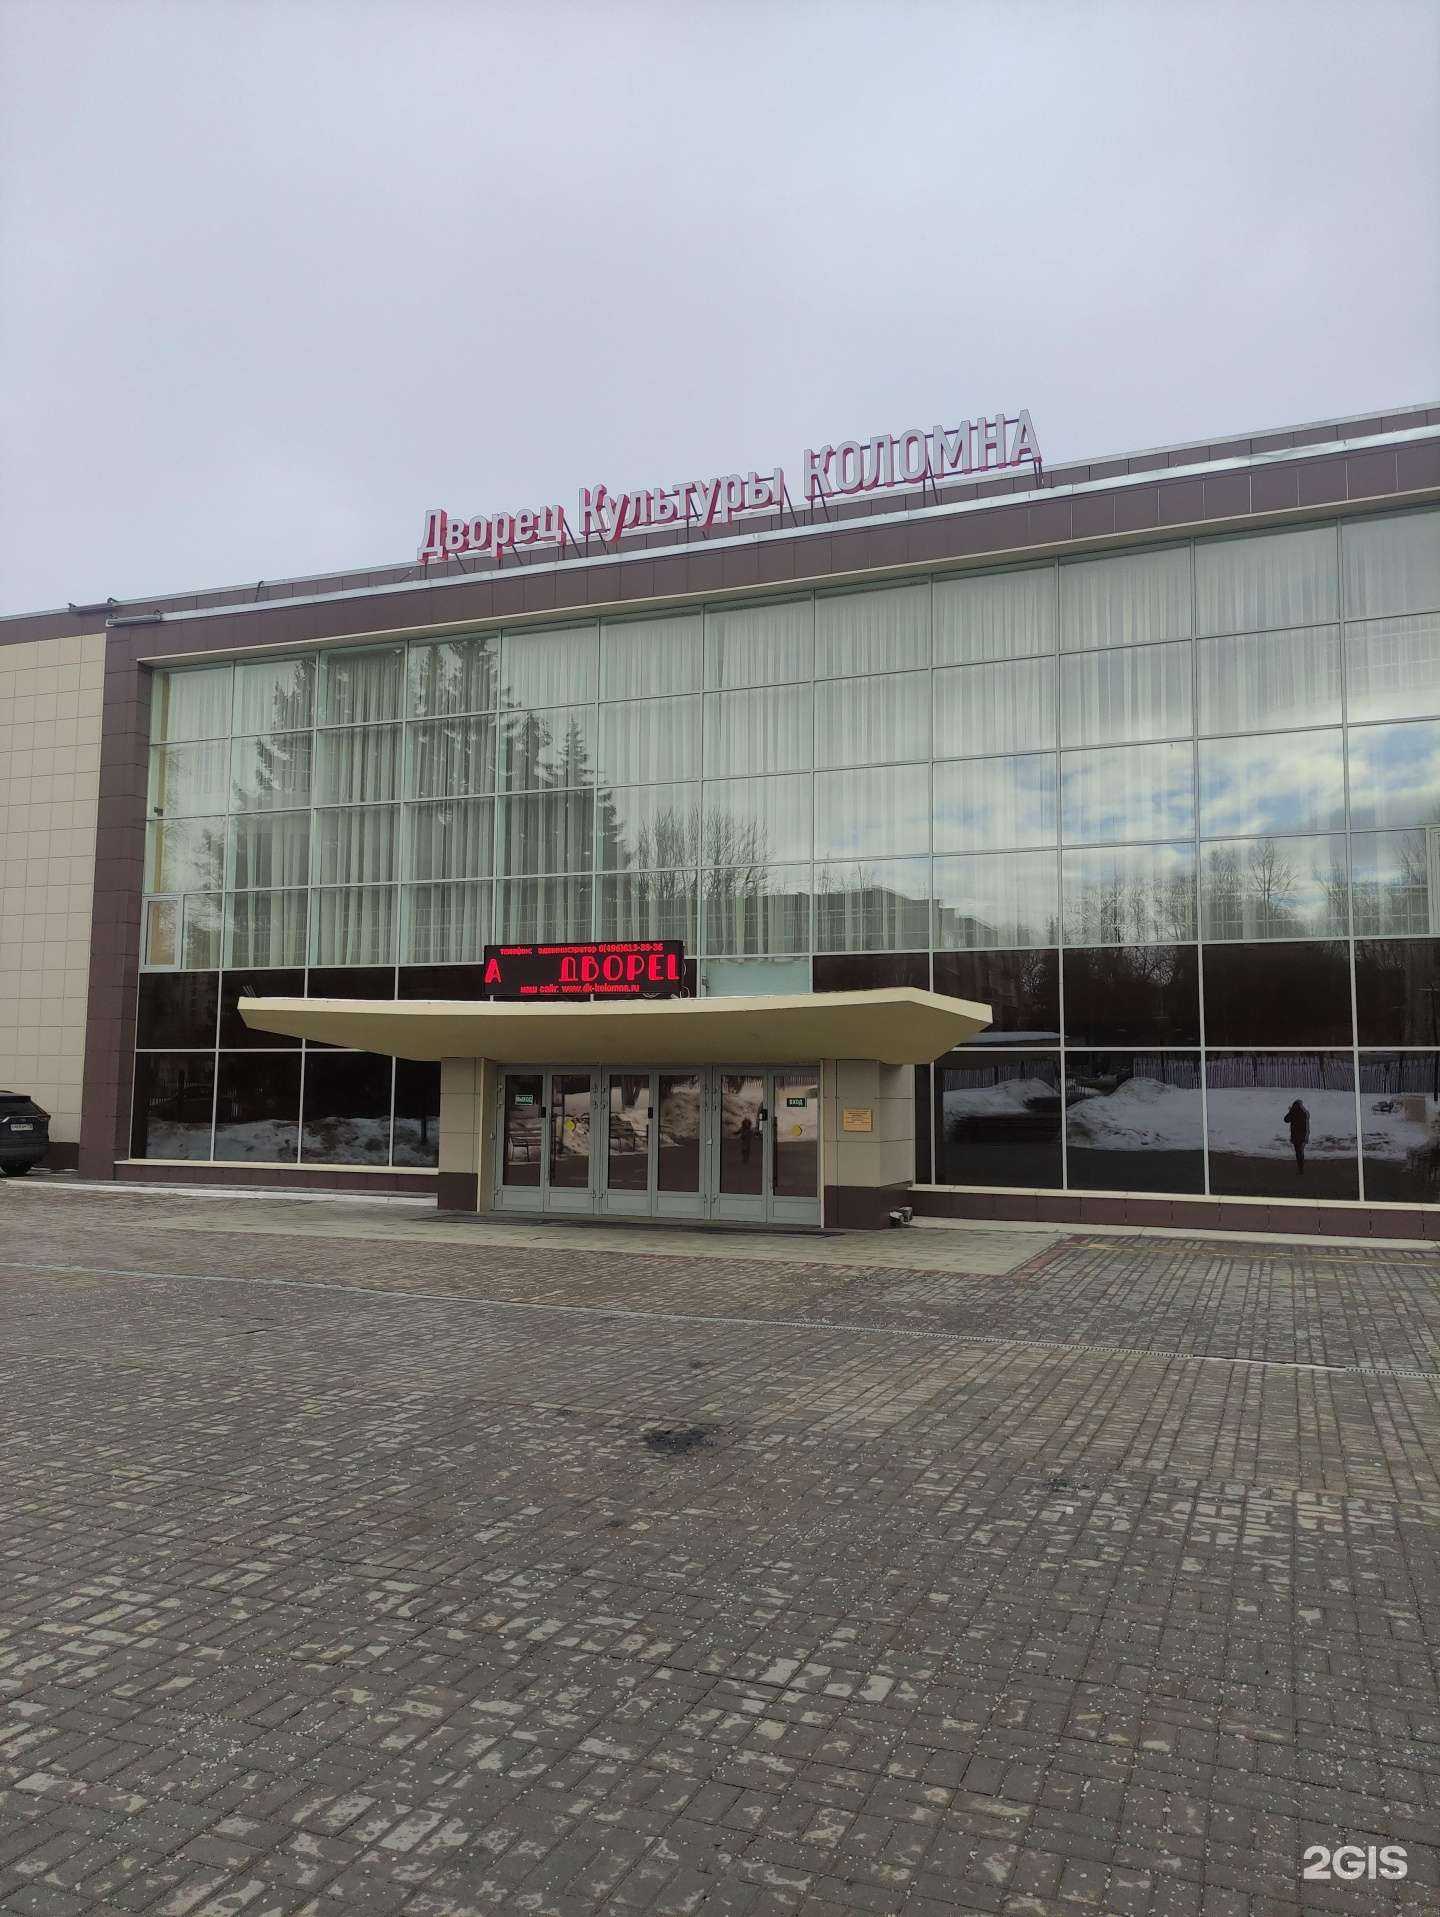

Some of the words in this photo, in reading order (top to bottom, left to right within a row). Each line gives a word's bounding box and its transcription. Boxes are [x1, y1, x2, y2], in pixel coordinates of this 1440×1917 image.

[417, 505, 567, 565] Дворец
[579, 467, 784, 543] Культуры
[804, 408, 1042, 500] КОЛОМНА
